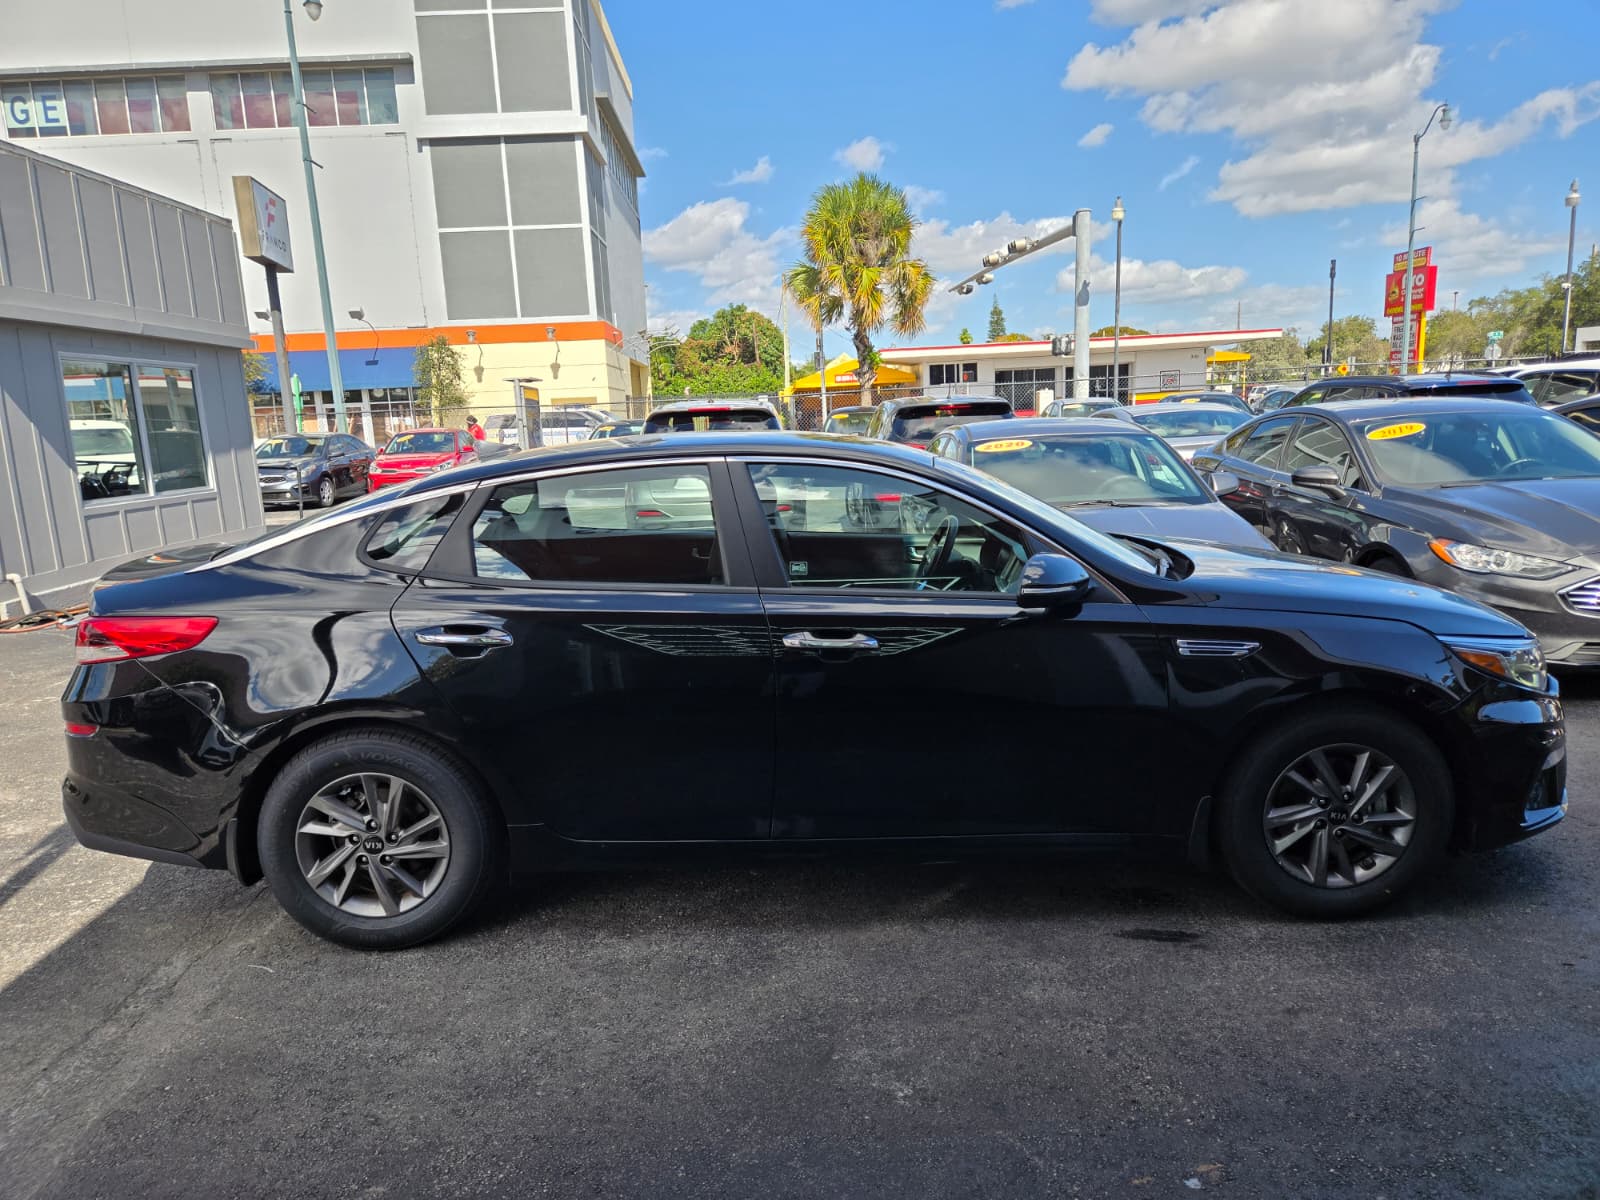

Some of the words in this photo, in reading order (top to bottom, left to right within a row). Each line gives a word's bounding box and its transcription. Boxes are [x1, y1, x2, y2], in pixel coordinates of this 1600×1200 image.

[10, 95, 60, 125] GE
[1382, 425, 1414, 438] 2019
[983, 441, 1025, 450] 2020
[1330, 812, 1347, 820] KIA
[364, 841, 382, 849] KIA
